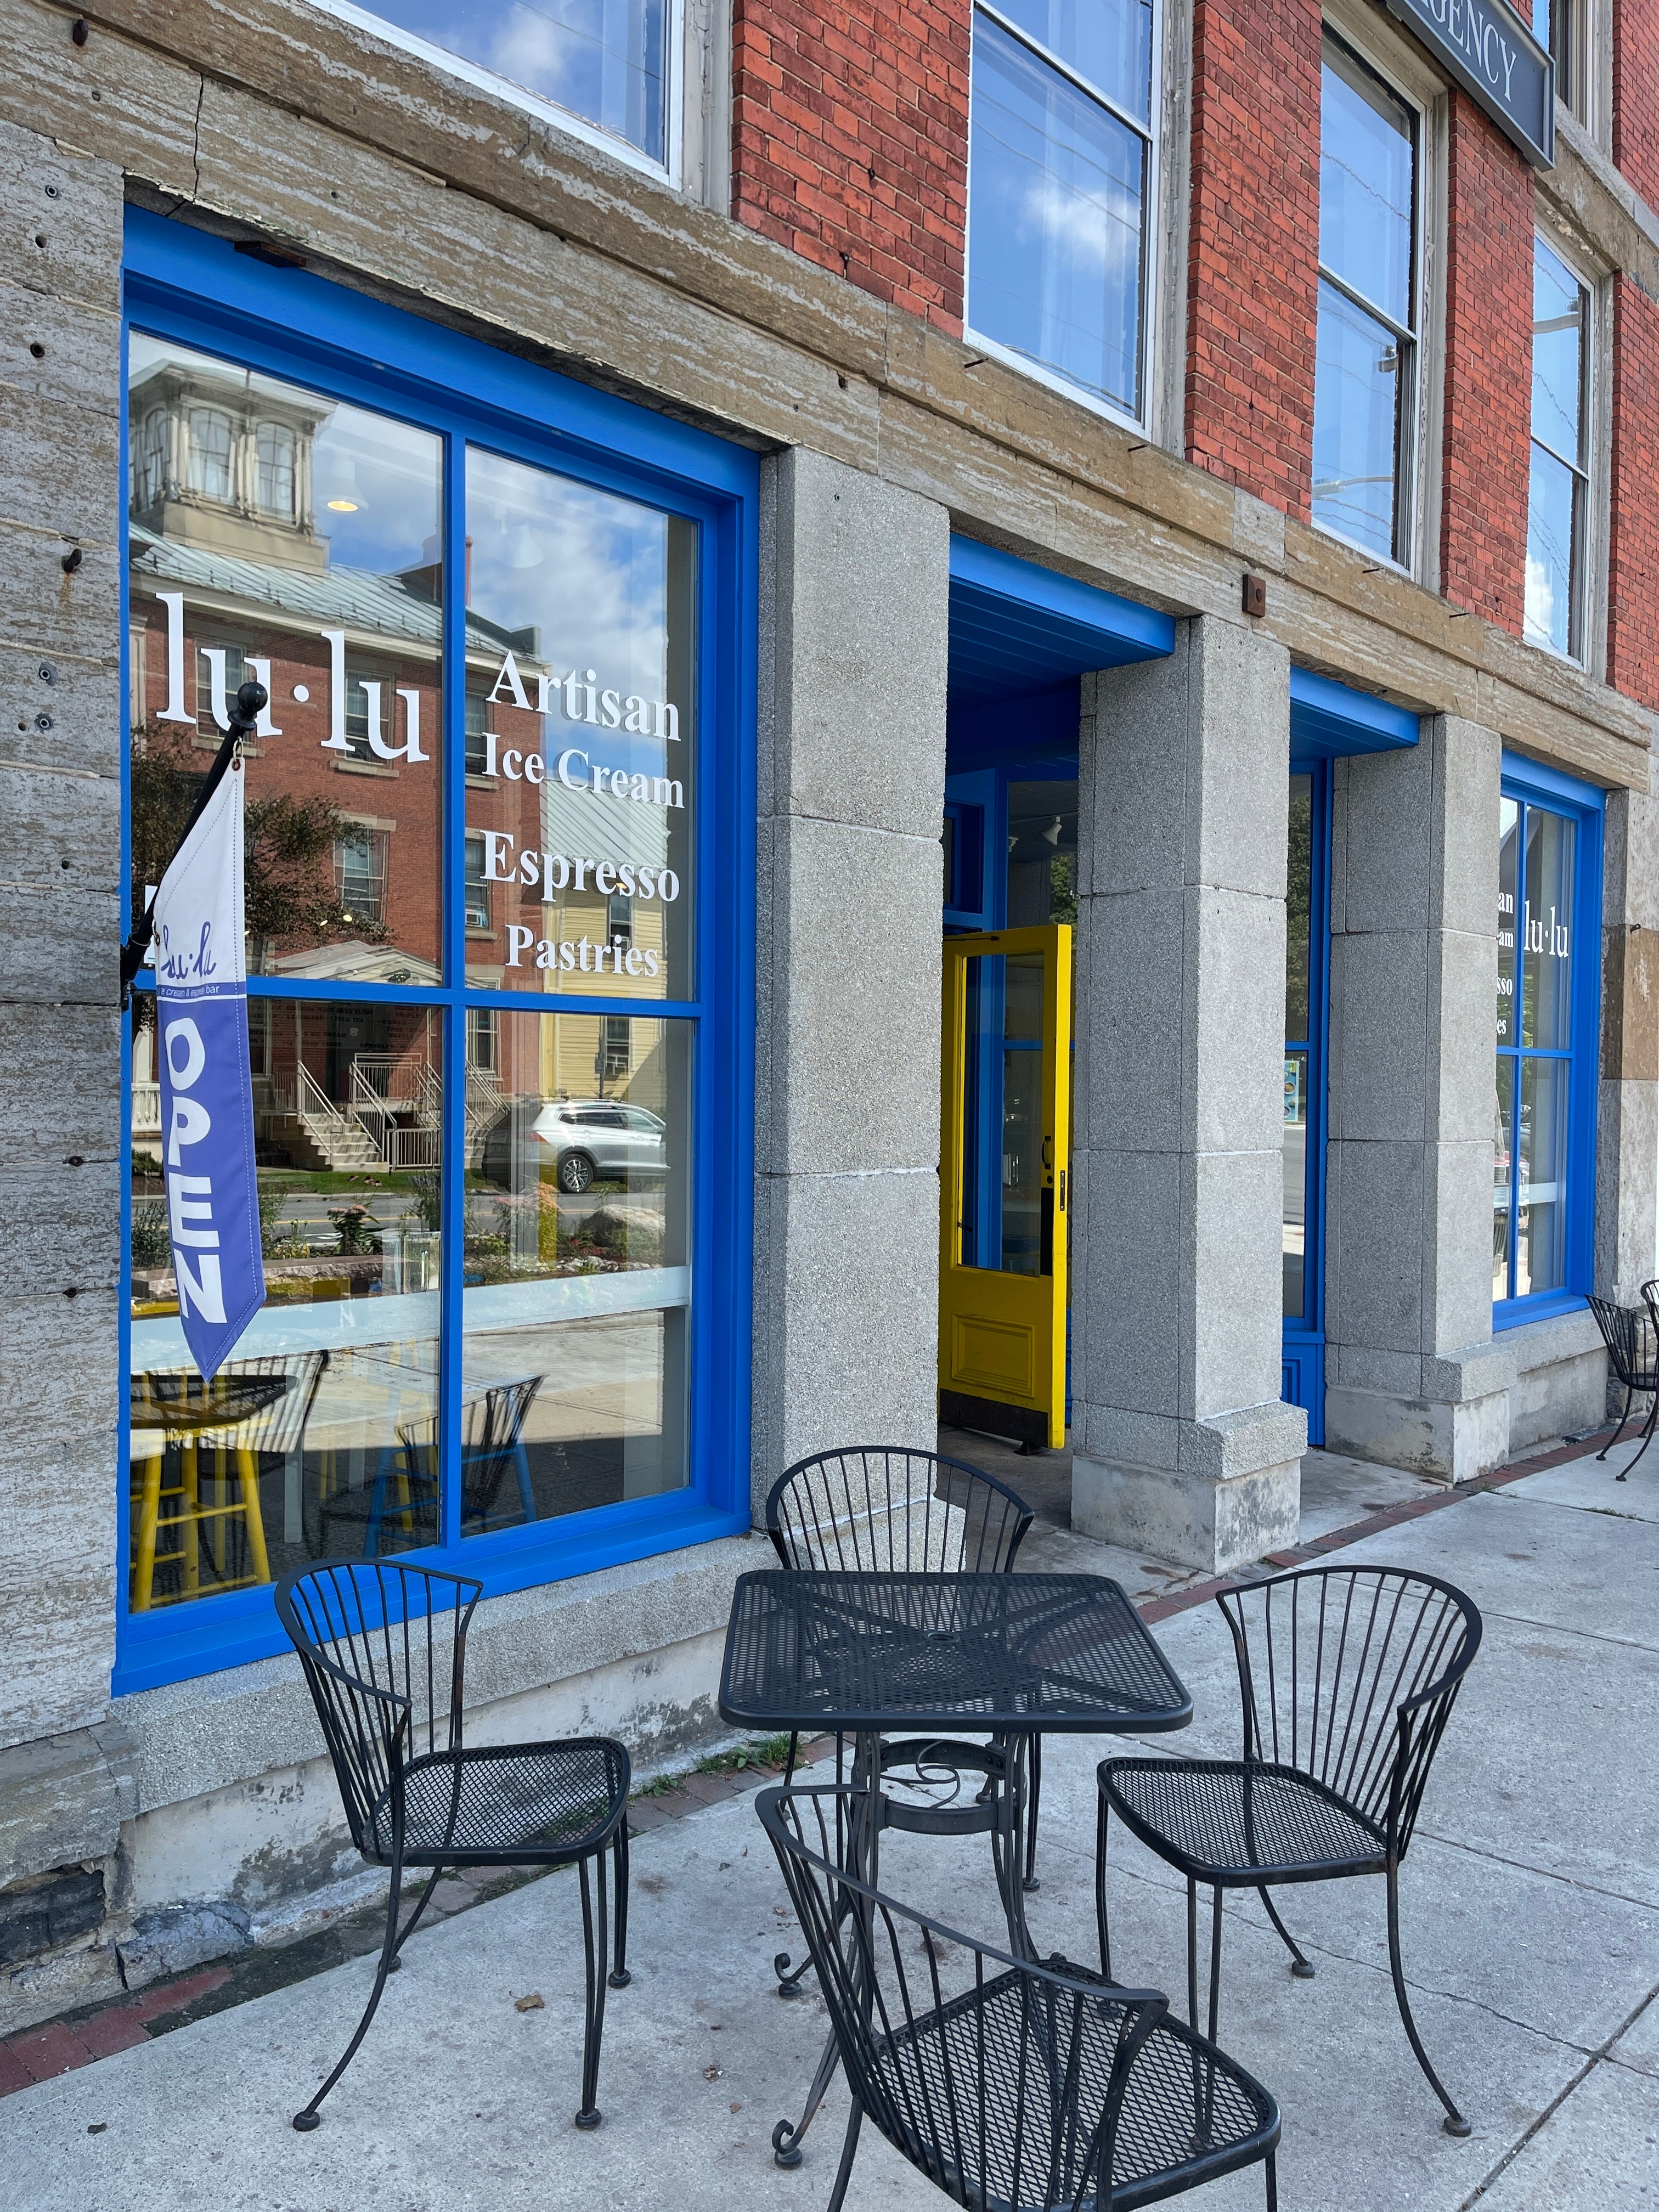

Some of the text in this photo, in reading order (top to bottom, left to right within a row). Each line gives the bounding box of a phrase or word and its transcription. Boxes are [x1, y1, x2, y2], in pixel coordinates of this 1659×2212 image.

[1420, 0, 1517, 102] ENCY
[486, 650, 681, 742] Artisan
[482, 732, 685, 809] Ice Cream
[480, 830, 680, 902] Espresso
[206, 985, 220, 994] bar
[505, 924, 659, 978] Pastries
[165, 1017, 228, 1324] OPEN
